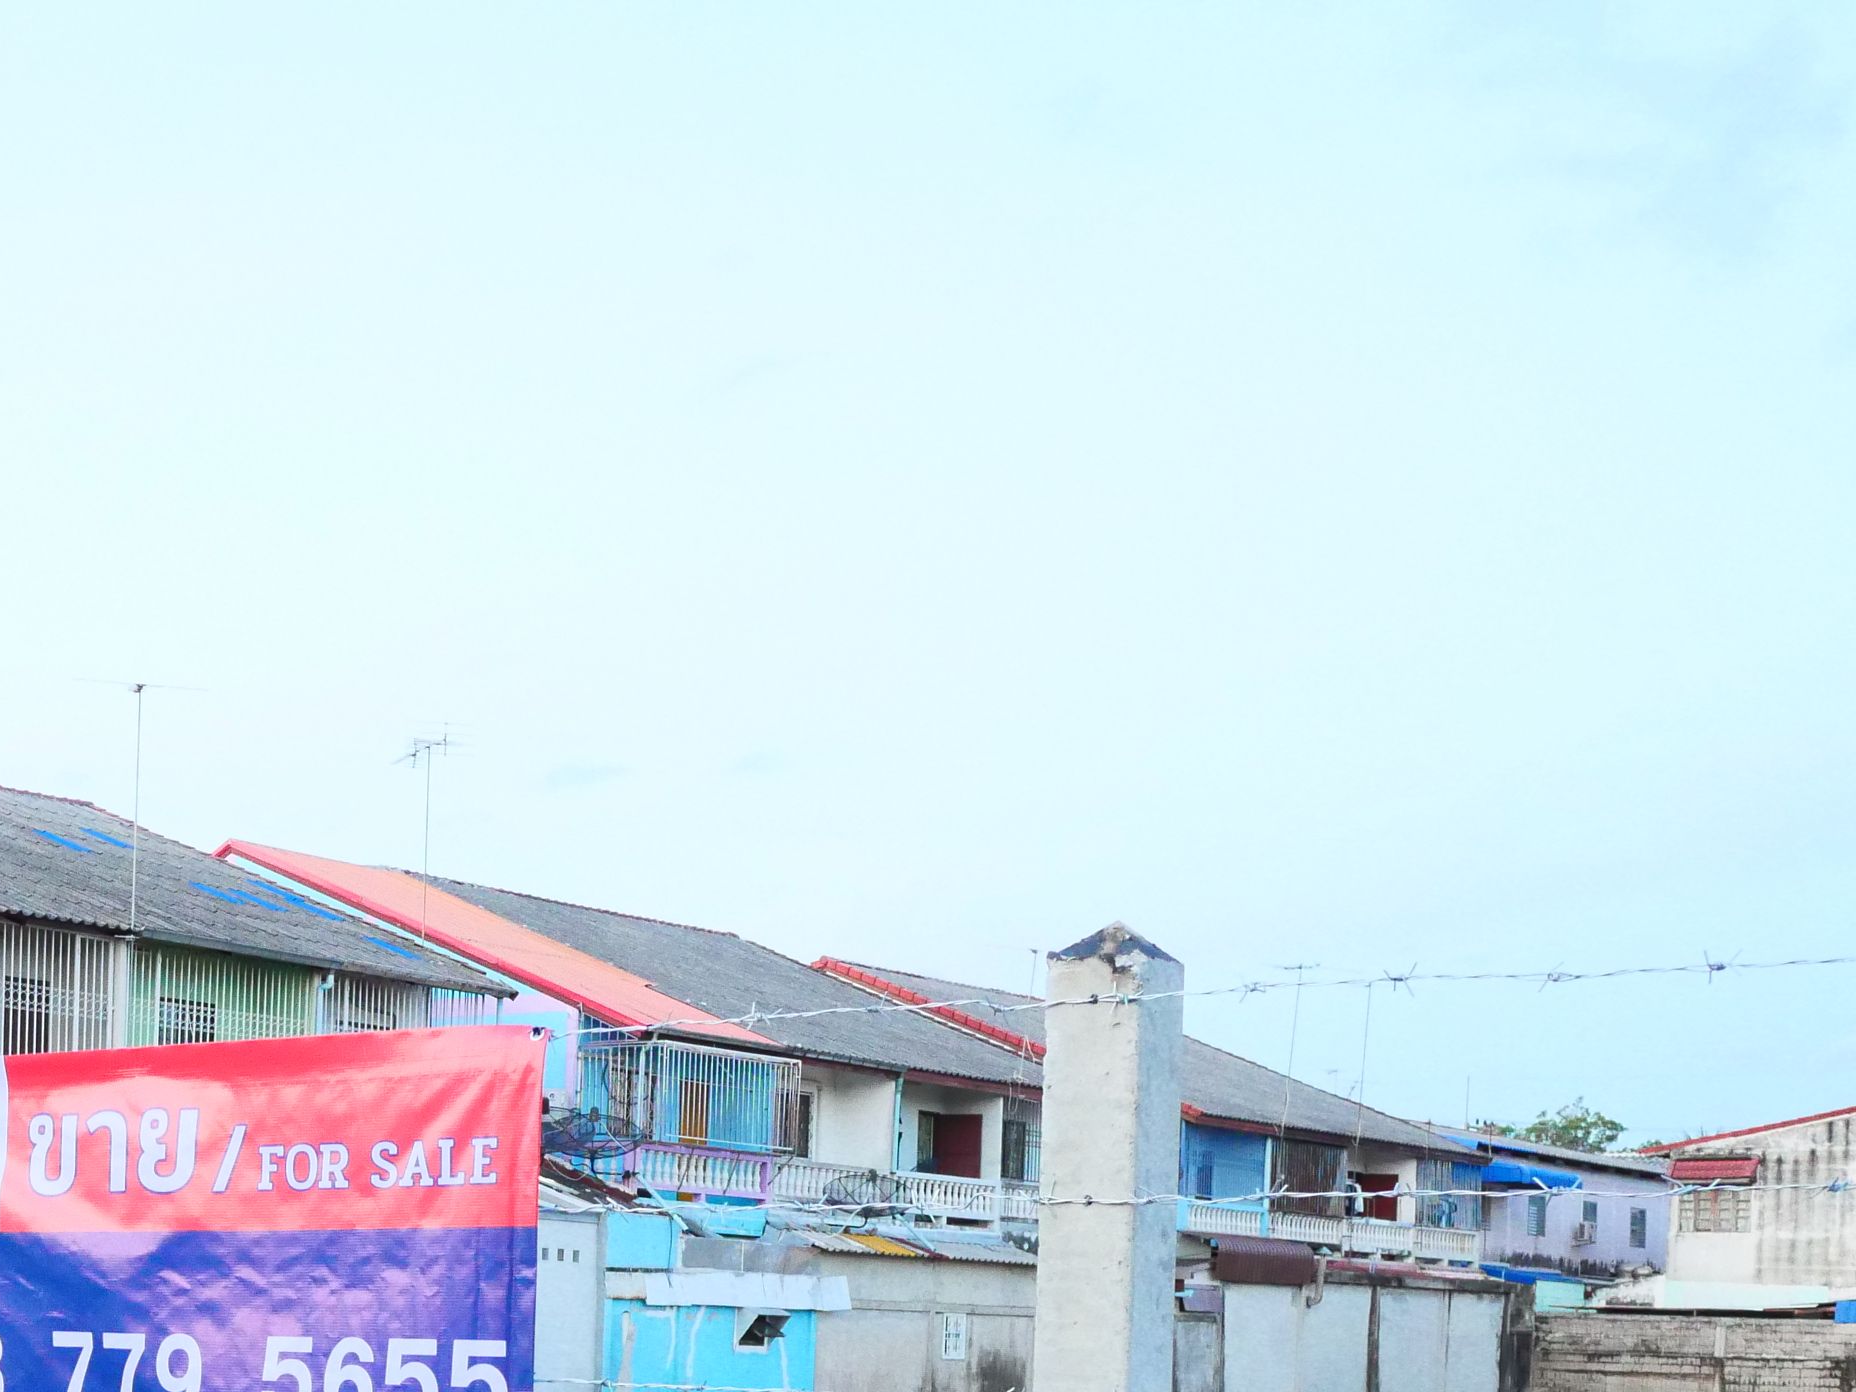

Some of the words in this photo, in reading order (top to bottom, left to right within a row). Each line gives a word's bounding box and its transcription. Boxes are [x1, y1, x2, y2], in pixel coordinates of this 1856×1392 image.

[28, 1107, 200, 1197] ขาย
[257, 1143, 350, 1191] FOR
[370, 1136, 499, 1190] SALE
